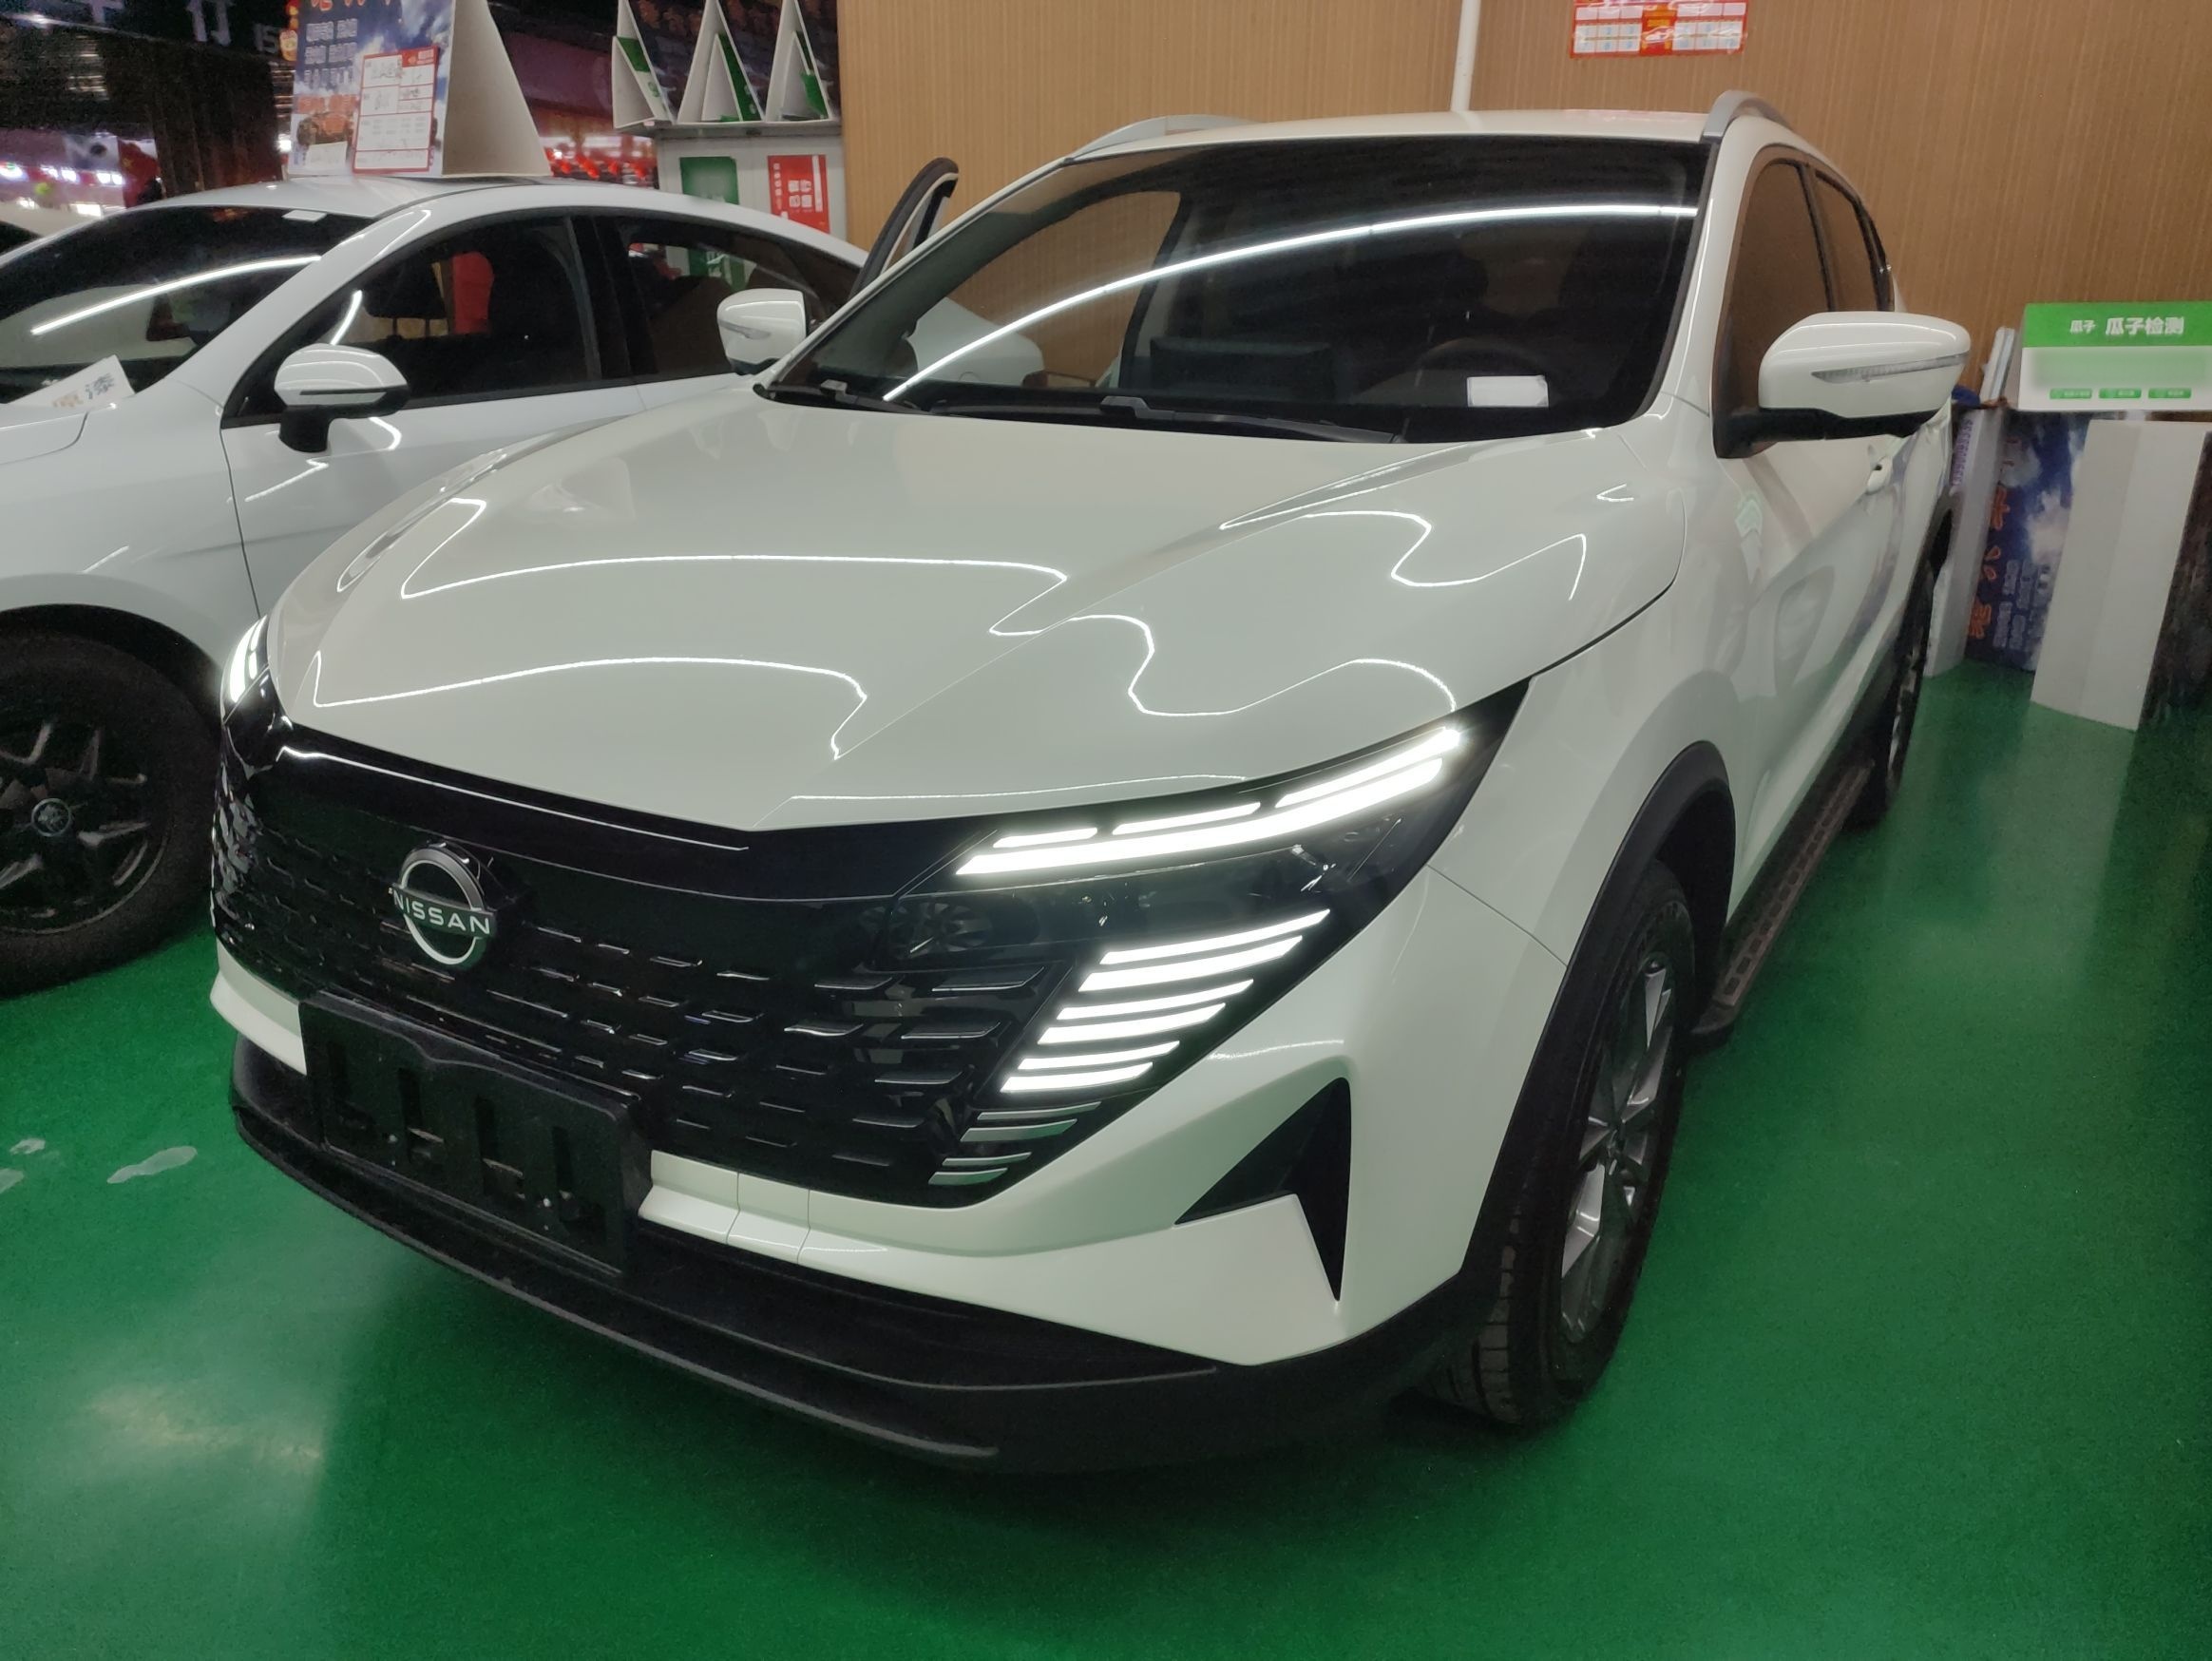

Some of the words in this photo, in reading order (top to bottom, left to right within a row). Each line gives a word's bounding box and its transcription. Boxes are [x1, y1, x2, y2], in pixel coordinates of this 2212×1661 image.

[2069, 319, 2096, 334] 瓜子
[2105, 316, 2184, 335] 瓜子检测
[393, 889, 490, 935] NISSAN
